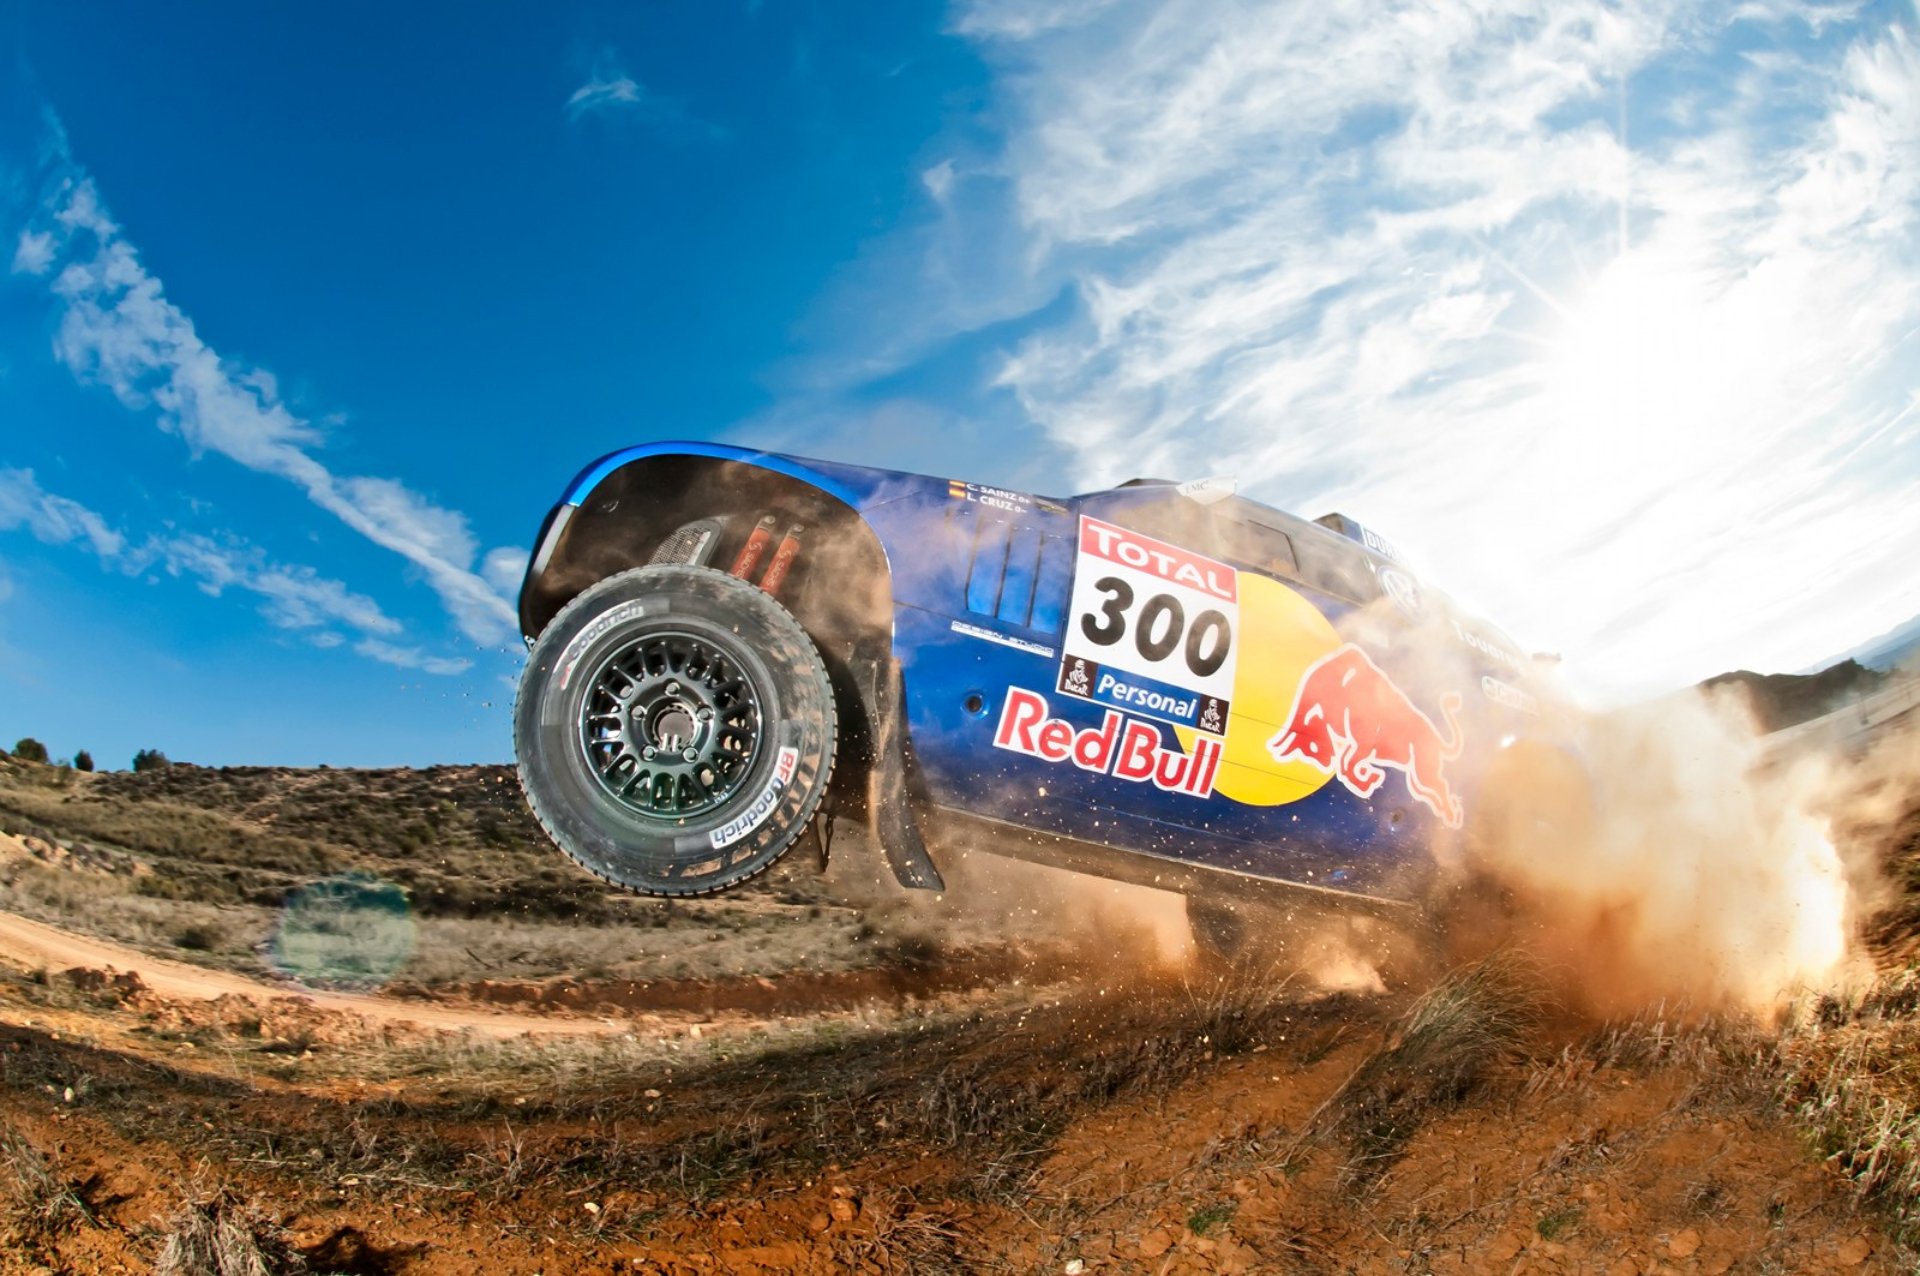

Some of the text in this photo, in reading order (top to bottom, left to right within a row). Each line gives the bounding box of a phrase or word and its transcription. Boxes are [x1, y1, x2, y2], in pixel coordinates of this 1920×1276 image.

[979, 495, 1013, 511] CRUZ
[980, 486, 1017, 500] SAINZ
[1087, 523, 1232, 599] TOTAL
[1080, 576, 1232, 678] 300
[1064, 678, 1088, 696] DAKAR
[1097, 673, 1197, 720] Personal
[995, 688, 1222, 797] Red Bull
[1199, 717, 1220, 734] DAKAR
[713, 752, 795, 844] BFGoodrich
